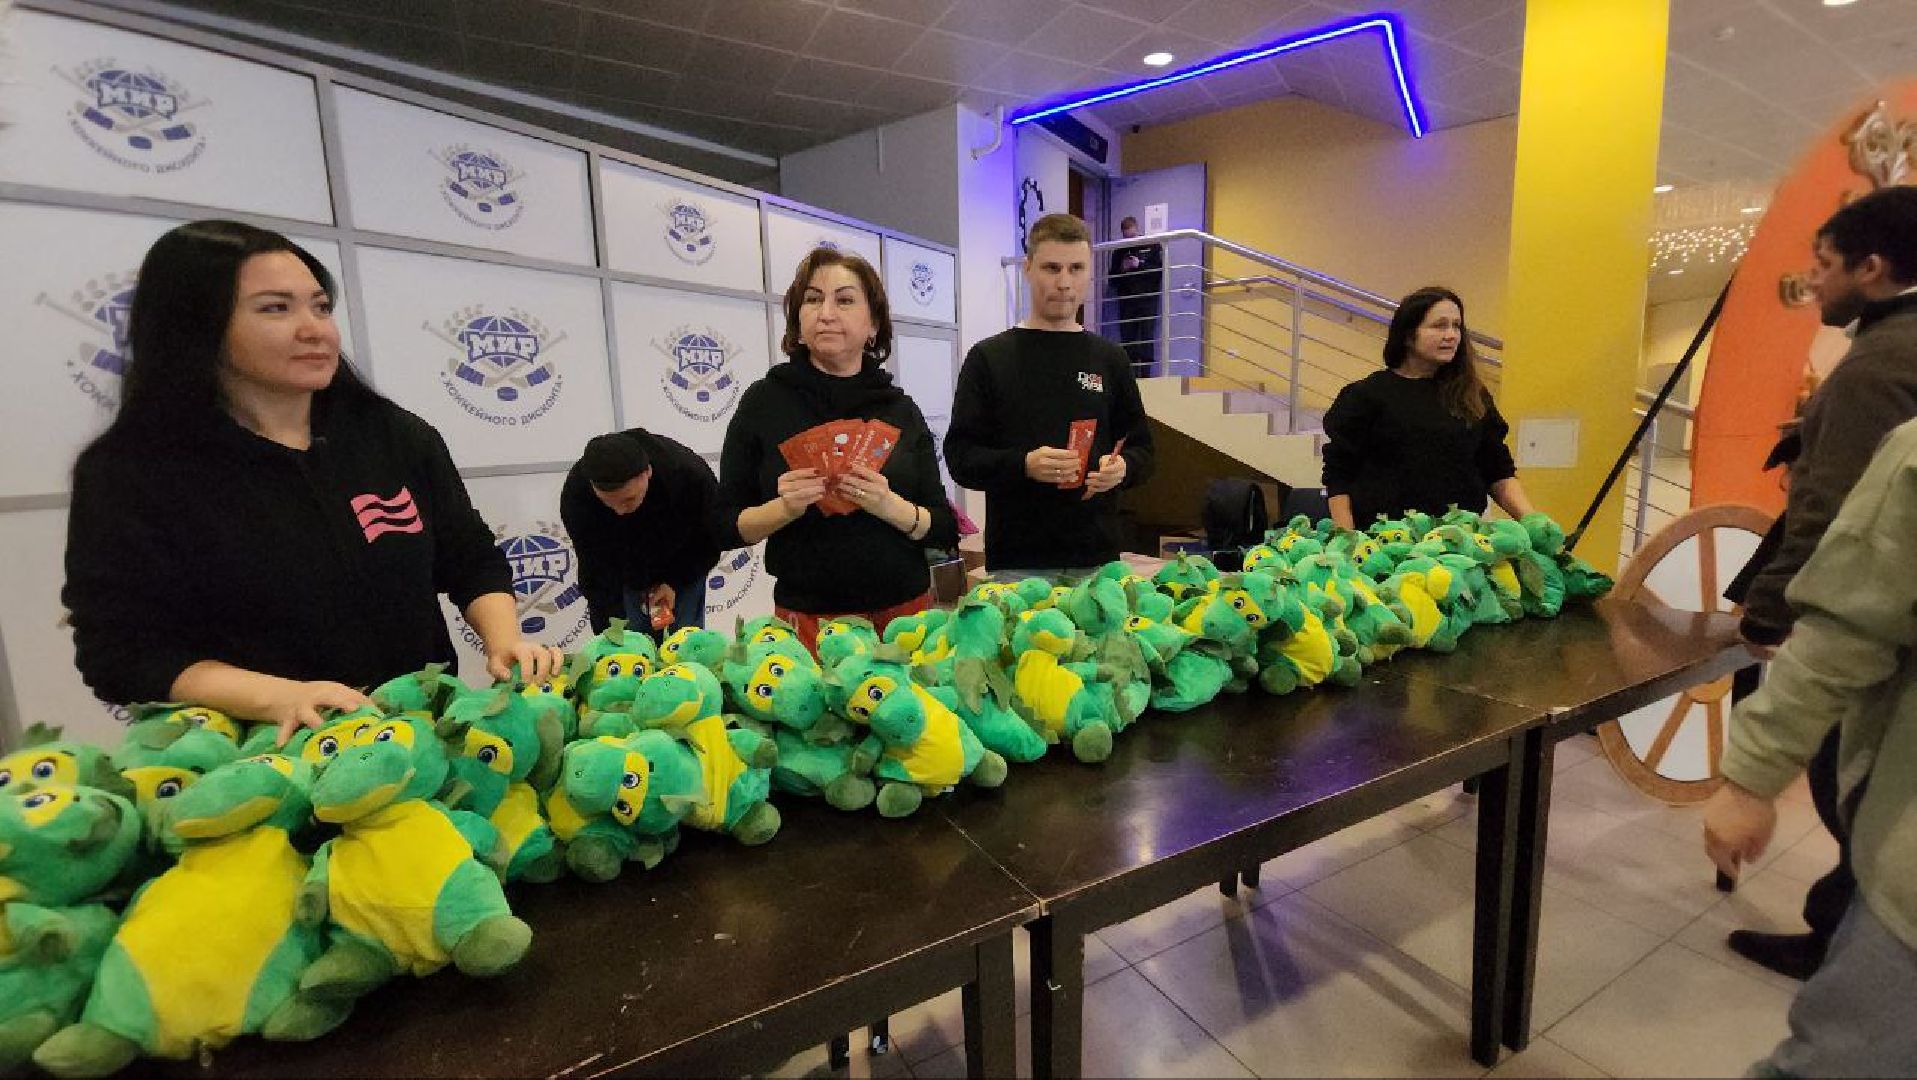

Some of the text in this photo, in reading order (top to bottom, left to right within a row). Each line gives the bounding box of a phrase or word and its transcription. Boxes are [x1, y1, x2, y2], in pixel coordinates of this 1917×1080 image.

[99, 80, 178, 119] МИР
[458, 162, 506, 188] МИР
[467, 331, 539, 362] МИР
[679, 347, 724, 371] МИР
[443, 380, 563, 426] ХОККЕЙНОГО ДИСКОНТА
